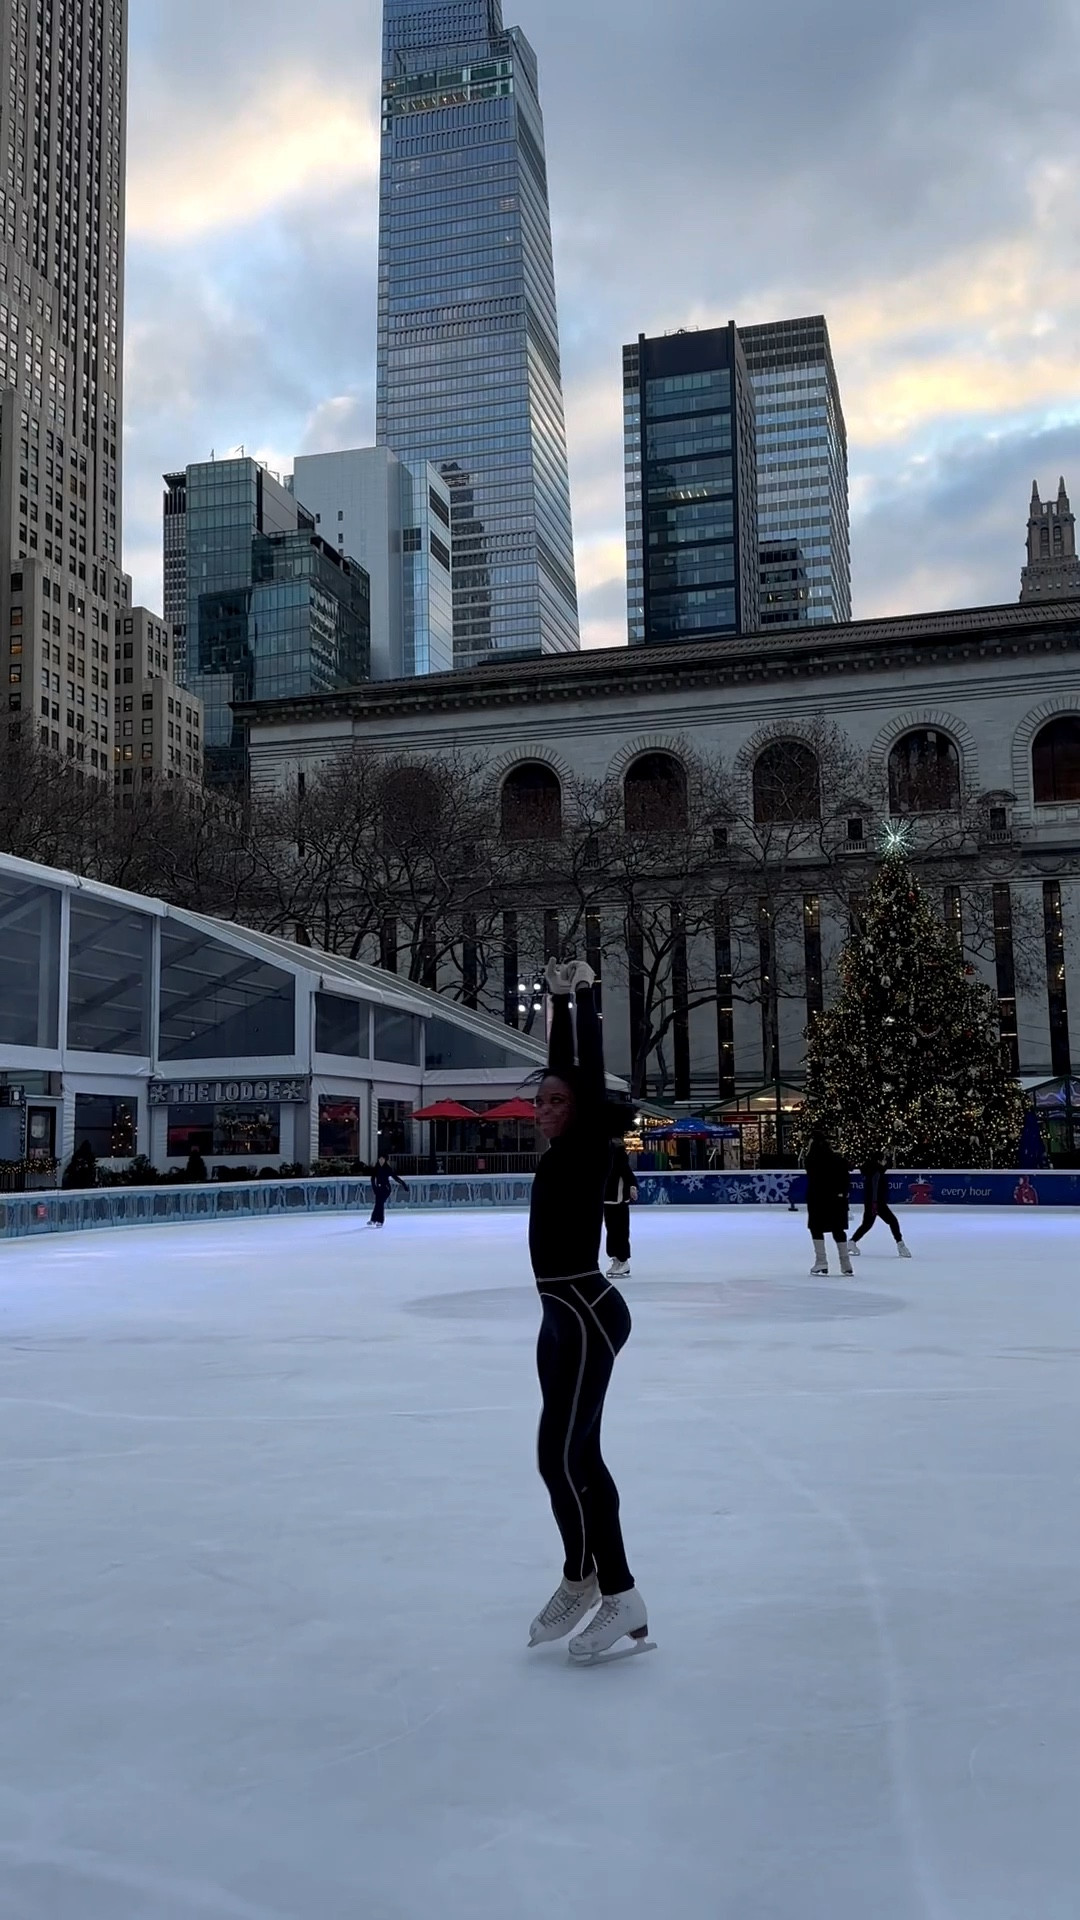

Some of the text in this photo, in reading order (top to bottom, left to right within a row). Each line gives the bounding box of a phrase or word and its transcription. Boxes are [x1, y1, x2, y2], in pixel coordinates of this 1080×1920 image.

[169, 1081, 281, 1103] THE LODGE
[941, 1186, 992, 1198] every hour
